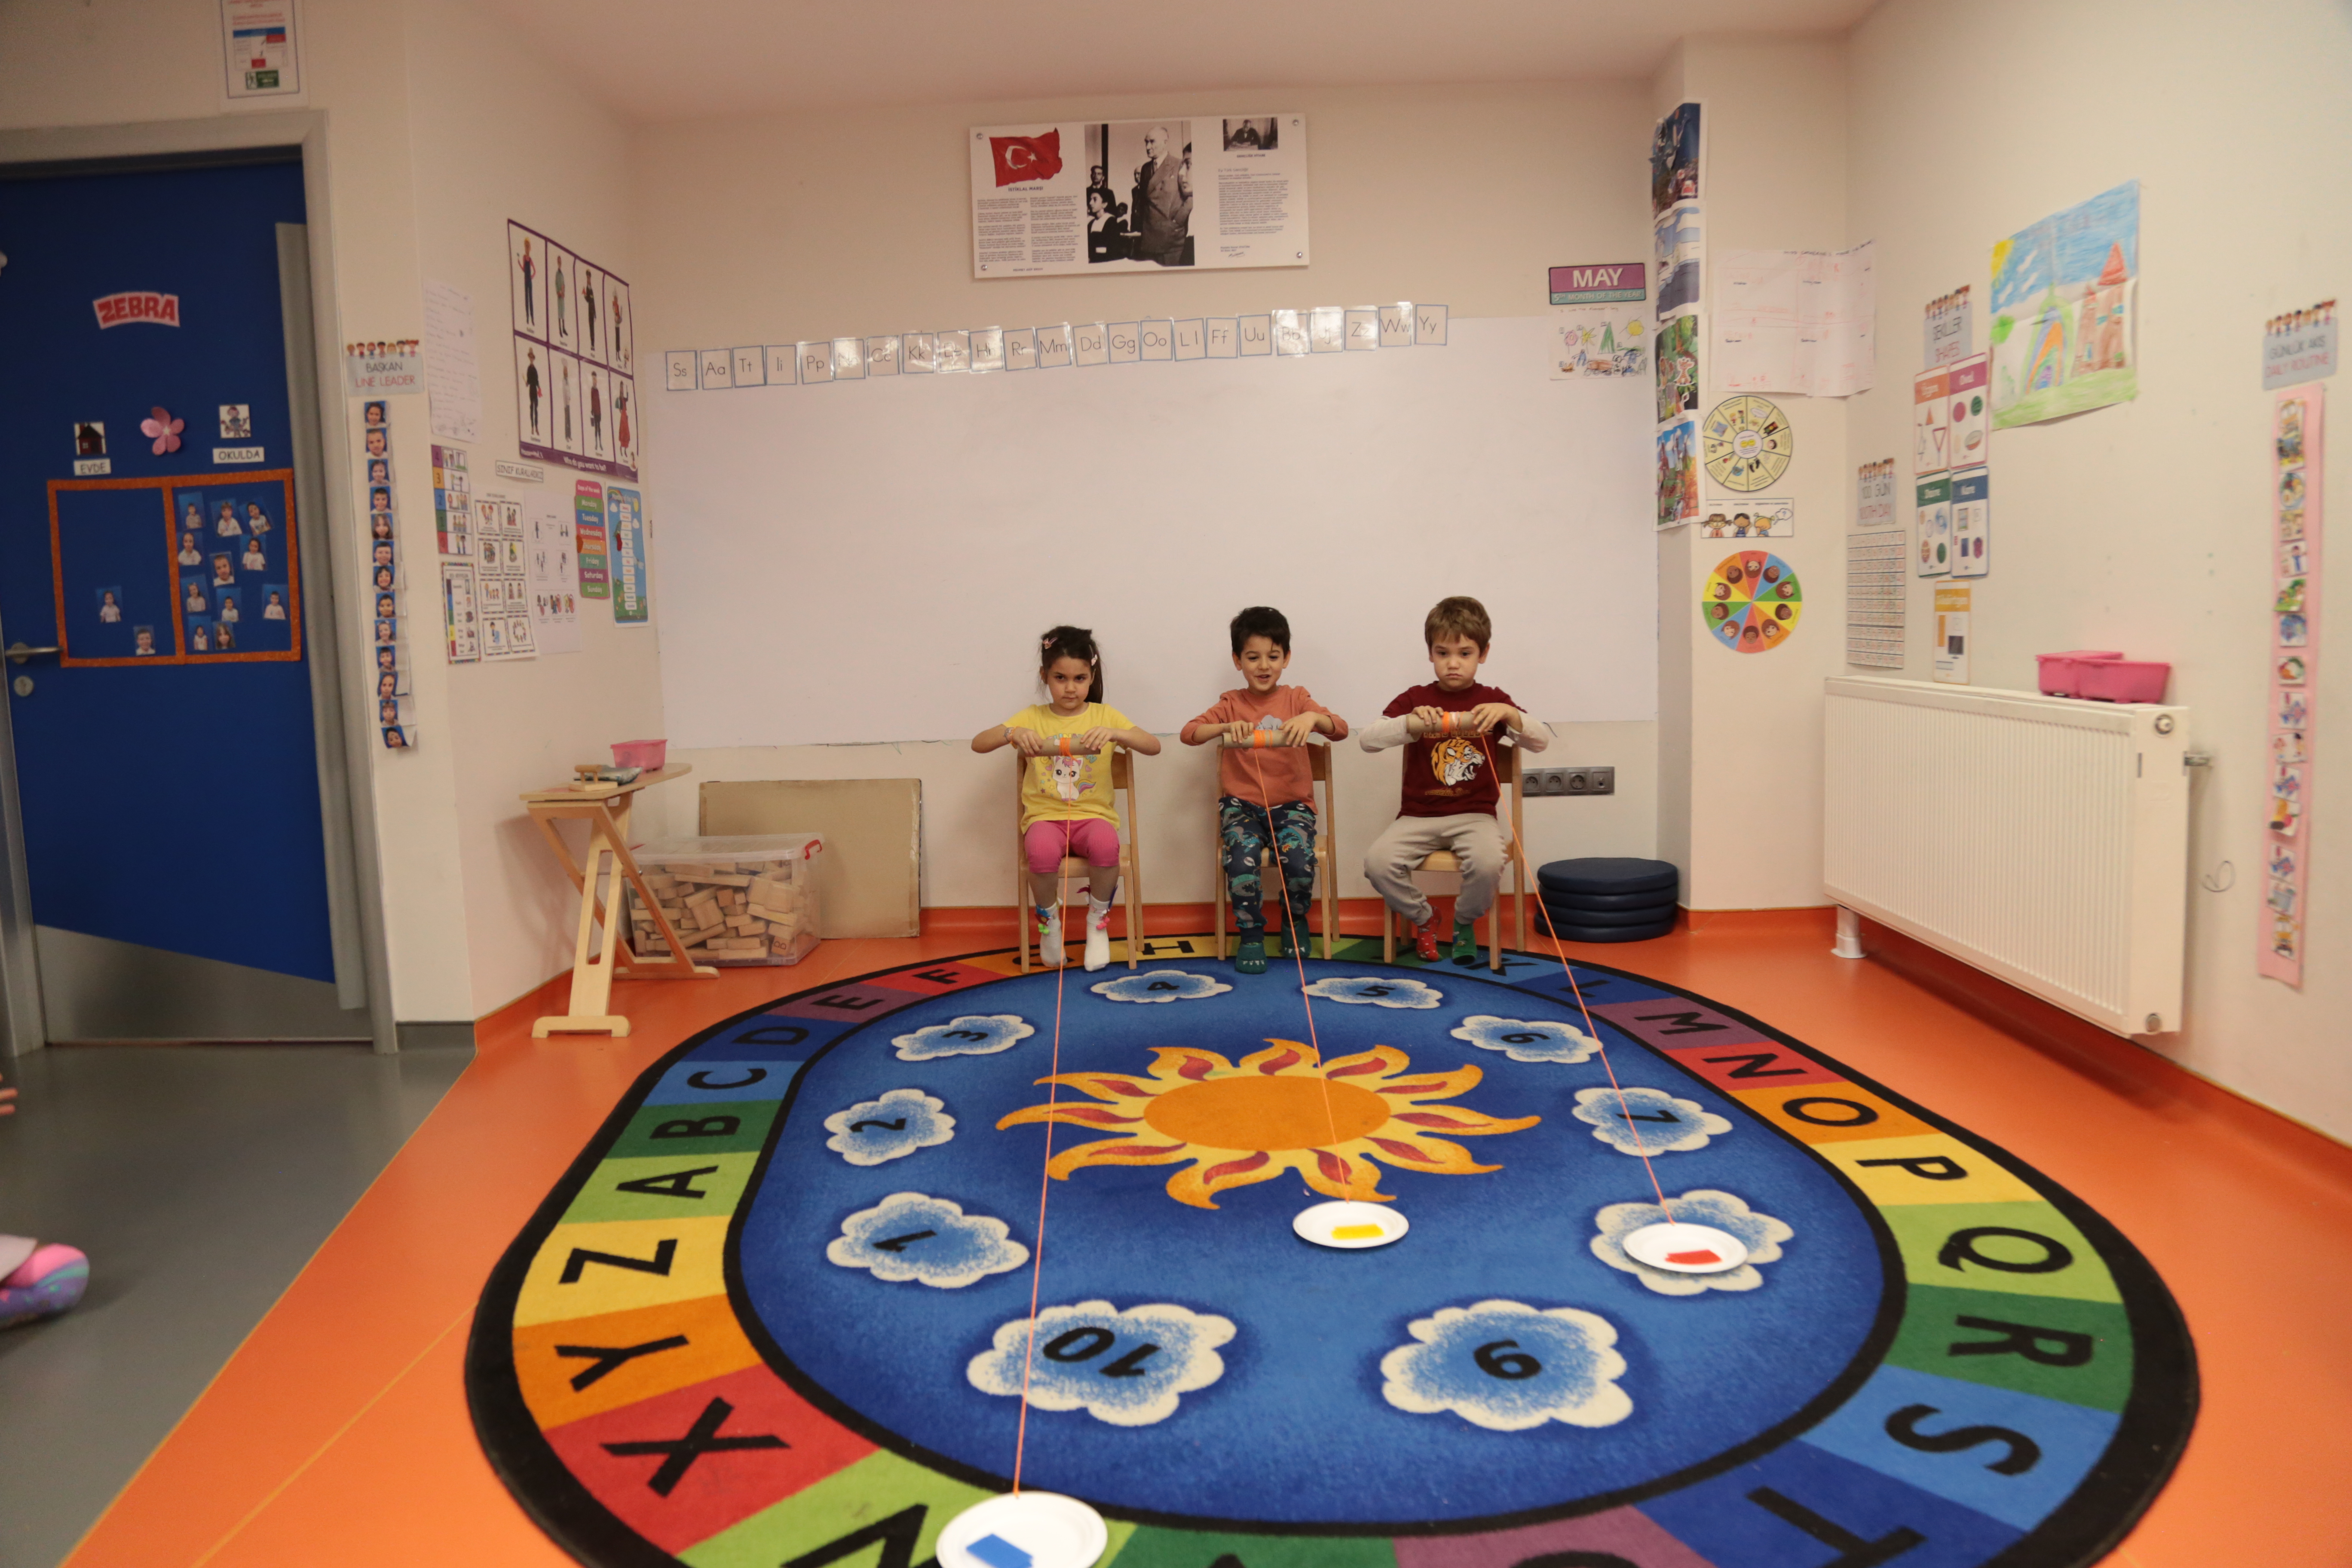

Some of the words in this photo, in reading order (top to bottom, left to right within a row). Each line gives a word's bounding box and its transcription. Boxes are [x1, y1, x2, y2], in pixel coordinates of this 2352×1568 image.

[1572, 267, 1623, 288] MAY
[98, 296, 176, 324] ZEBRA
[674, 363, 687, 377] Ss
[705, 362, 726, 376] Aa
[739, 358, 752, 372] Tt
[806, 355, 824, 372] Pp
[871, 348, 891, 362] Cc
[909, 345, 925, 360] Kk
[976, 343, 997, 358] Hh
[1011, 341, 1026, 356] Rr
[1039, 338, 1067, 354] Mm
[1081, 335, 1101, 352] Dd
[1112, 335, 1135, 354] Gg
[1143, 332, 1167, 346] Oo
[1212, 329, 1228, 344] Ff
[1245, 327, 1265, 342] Uu
[1282, 327, 1301, 341] Bb
[1351, 322, 1369, 337] Zz
[1381, 318, 1411, 333] Ww
[1419, 316, 1436, 334] Yy
[366, 361, 403, 374] BAŞKAN
[355, 376, 375, 388] LINE
[379, 374, 416, 386] LEADER
[218, 450, 260, 461] OKULDA
[80, 462, 107, 474] EVDE
[497, 464, 514, 474] SINIF
[436, 473, 441, 484] 3
[438, 494, 443, 506] 2
[582, 499, 597, 509] Monday
[582, 513, 599, 524] Tuesday
[586, 557, 600, 567] Friday
[584, 571, 603, 581] Saturday
[587, 585, 603, 594] Sunday
[1142, 940, 1195, 956] H
[912, 969, 961, 984] F
[1147, 981, 1180, 991] 4
[1355, 985, 1396, 997] 5
[1557, 980, 1611, 998] L
[811, 994, 884, 1011] E
[1633, 1011, 1730, 1036] M
[732, 1026, 810, 1045] D
[945, 1029, 989, 1042] 3
[1500, 1032, 1551, 1044] 6
[1702, 1053, 1809, 1079] N
[687, 1068, 767, 1090] C
[1615, 1109, 1681, 1124] 7
[1782, 1096, 1879, 1127] O
[649, 1116, 741, 1139] B
[849, 1118, 906, 1133] 2
[1854, 1155, 1968, 1180] P
[616, 1165, 719, 1199] A
[872, 1229, 937, 1253] 1
[1938, 1226, 2074, 1274] Q
[558, 1239, 678, 1284] Z
[1947, 1314, 2094, 1368] R
[1042, 1326, 1163, 1378] 10
[554, 1334, 690, 1393] Y
[599, 1396, 792, 1498] X
[1883, 1403, 2042, 1476] S
